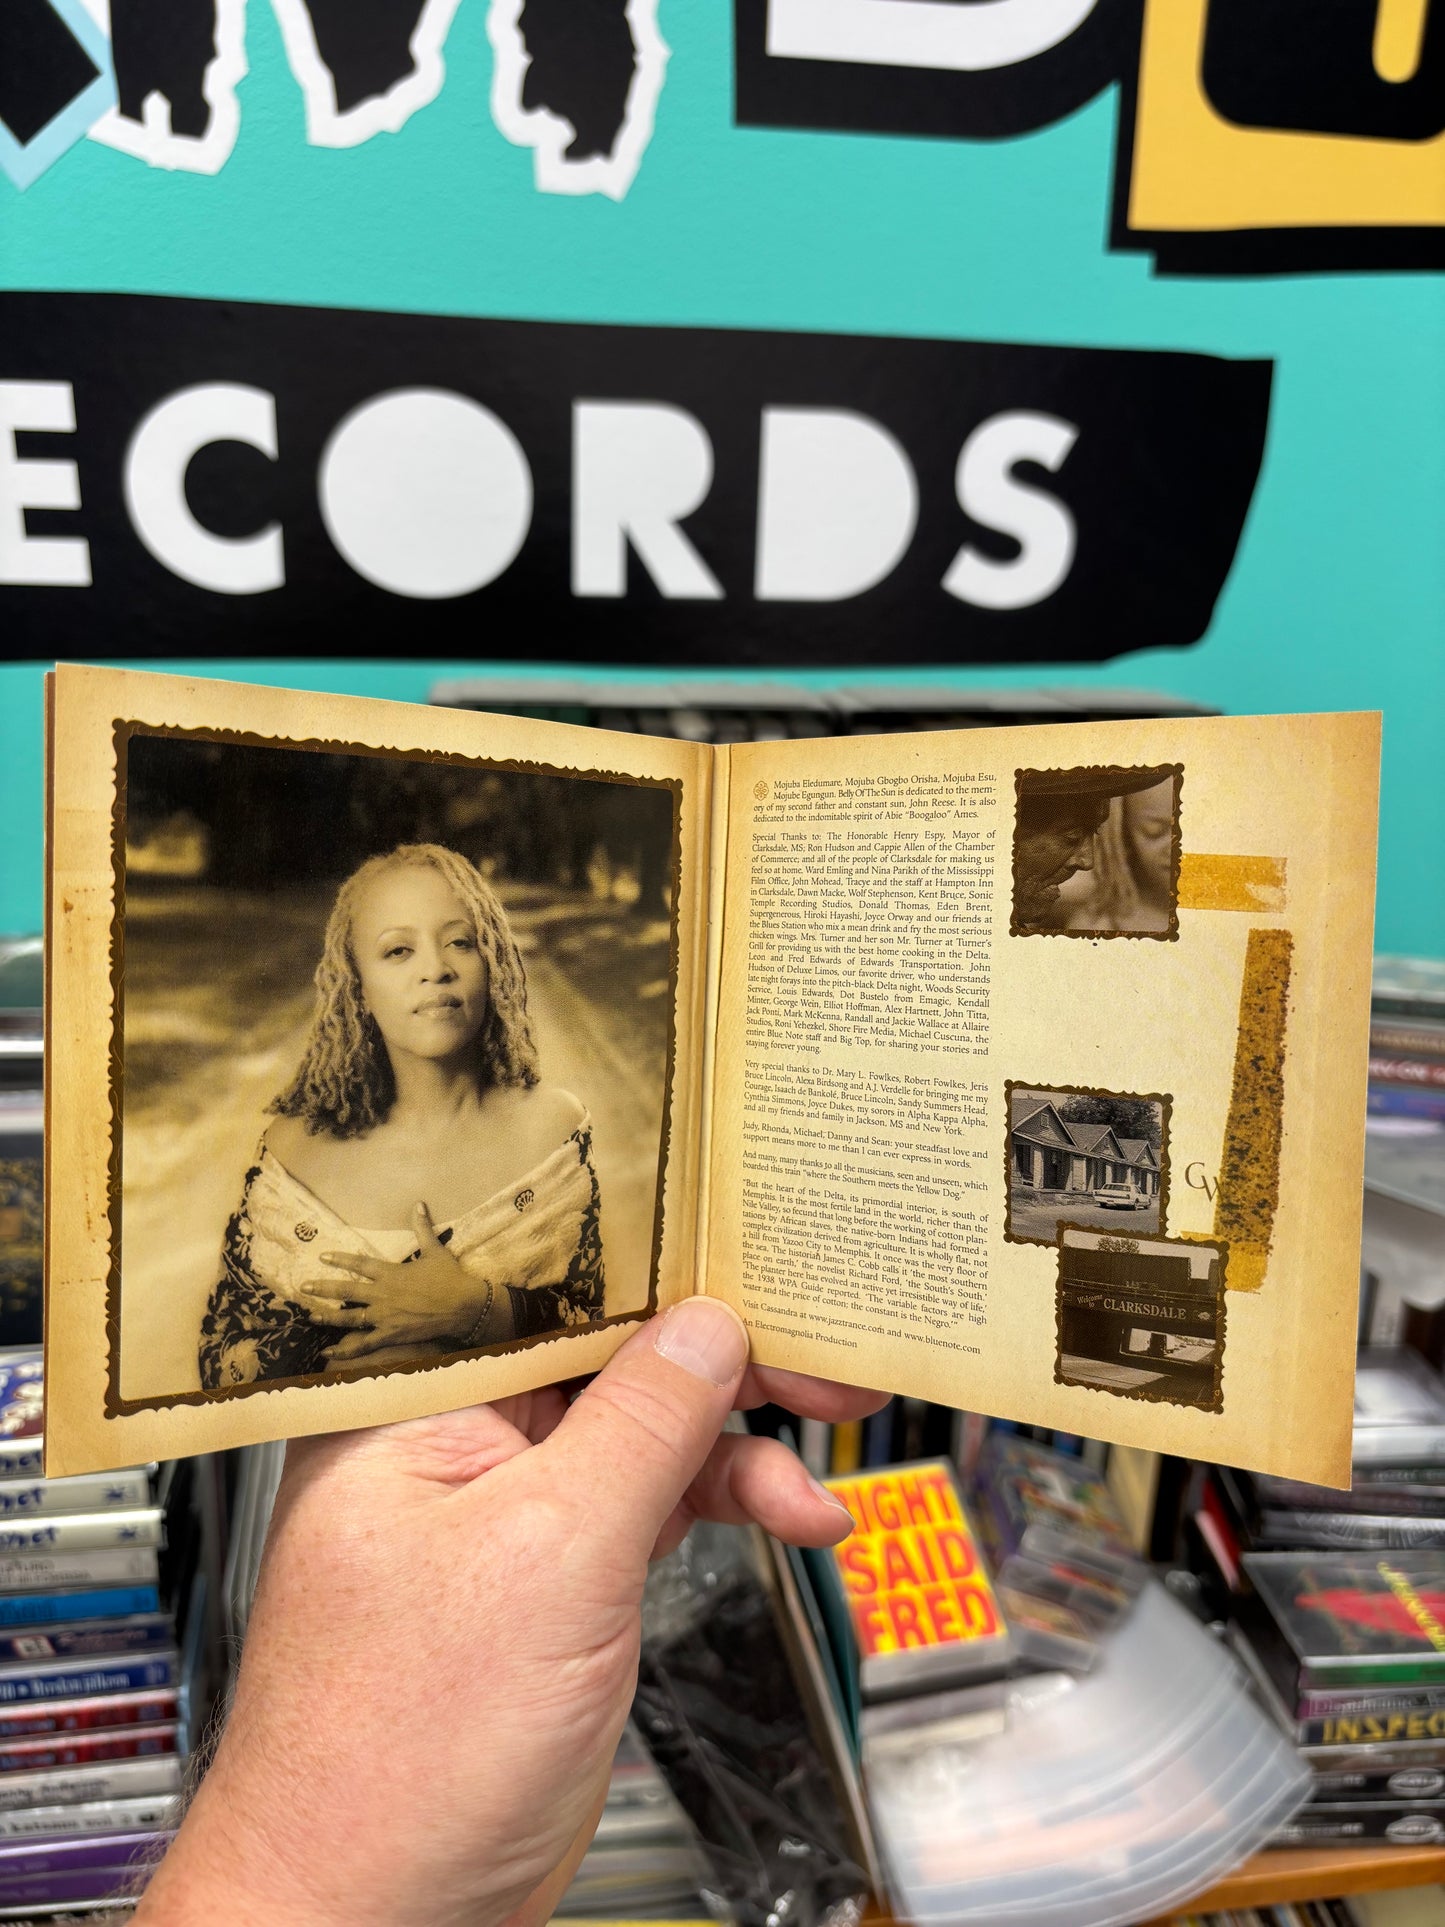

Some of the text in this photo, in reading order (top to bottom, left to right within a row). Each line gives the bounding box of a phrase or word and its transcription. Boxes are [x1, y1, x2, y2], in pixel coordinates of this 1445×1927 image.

[773, 772, 996, 791] Mojuba Eledumare, Mojuba Gbogbo Orisha, Mojuba Esu,
[751, 843, 788, 852] Clarksdale,
[807, 843, 822, 852] Ron
[824, 842, 854, 851] Hudson
[856, 842, 871, 851] and
[872, 842, 901, 854] Cappie
[903, 842, 924, 851] Allen
[927, 842, 937, 851] of
[938, 842, 952, 851] the
[954, 841, 995, 851] Chamber
[752, 832, 776, 843] Special
[780, 832, 807, 840] Thanks
[826, 831, 842, 840] The
[846, 831, 888, 840] Honorable
[893, 830, 918, 841] Henry
[924, 830, 945, 841] Espy,
[952, 829, 980, 841] Mayor
[986, 829, 996, 838] of
[750, 897, 992, 912] Temple Recording Studios, Donald Thomas, Eden Brent,
[758, 887, 795, 896] Clarksdale,
[797, 887, 818, 896] Dawn
[819, 888, 846, 897] Macke,
[847, 888, 867, 897] Wolf
[867, 888, 916, 900] Stephenson,
[918, 889, 938, 898] Kent
[940, 889, 966, 900] Bruce,
[968, 890, 993, 899] Sonic
[748, 952, 990, 972] Leon and Fred Edwards of Edwards Transportation. John
[748, 962, 774, 972] Hudson
[776, 964, 784, 973] of
[786, 964, 812, 974] Deluxe
[814, 966, 839, 976] Limos,
[858, 968, 887, 978] favorite
[889, 970, 914, 980] driver,
[917, 971, 935, 981] who
[938, 972, 990, 983] understands
[746, 994, 771, 1005] Minter,
[772, 996, 798, 1008] George
[800, 998, 821, 1009] Wein,
[845, 1001, 882, 1013] Hoffman,
[884, 1004, 902, 1014] Alex
[944, 1007, 963, 1018] John
[966, 1009, 989, 1020] Titta,
[776, 986, 797, 995] Louis
[840, 989, 854, 999] Dot
[859, 991, 889, 1001] Bustelo
[894, 993, 913, 1003] from
[957, 997, 989, 1008] Kendall
[745, 1006, 760, 1015] Jack
[761, 1007, 781, 1017] Ponti,
[783, 1008, 803, 1018] Mark
[804, 1010, 842, 1022] McKenna,
[844, 1012, 873, 1023] Randall
[875, 1015, 890, 1024] and
[891, 1016, 915, 1026] Jackie
[917, 1017, 949, 1028] Wallace
[961, 1021, 989, 1031] Allaire
[771, 1094, 806, 1107] Simmons,
[807, 1098, 827, 1110] Joyce
[829, 1100, 855, 1112] Dukes,
[857, 1106, 869, 1115] my
[870, 1107, 894, 1116] sorors
[897, 1108, 905, 1117] in
[907, 1109, 930, 1121] Alpha
[933, 1112, 958, 1125] Kappa
[960, 1115, 988, 1128] Alpha,
[774, 1084, 796, 1094] Isaach
[797, 1086, 806, 1095] de
[840, 1090, 862, 1101] Bruce
[864, 1093, 896, 1105] Lincoln,
[897, 1096, 922, 1110] Sandy
[923, 1099, 961, 1112] Summers
[963, 1104, 988, 1116] Head,
[742, 1210, 766, 1220] tations
[768, 1212, 777, 1224] by
[779, 1215, 806, 1226] African
[809, 1219, 832, 1231] slaves,
[835, 1223, 848, 1233] the
[850, 1227, 895, 1241] native-born
[898, 1233, 928, 1246] Indians
[931, 1238, 946, 1249] had
[949, 1241, 979, 1255] formed
[742, 1270, 753, 1280] the
[758, 1273, 774, 1284] 1938
[778, 1276, 797, 1288] WPA
[800, 1281, 823, 1292] Guide
[827, 1288, 861, 1299] reported.
[887, 1298, 917, 1310] variable
[920, 1303, 947, 1316] factors
[951, 1311, 964, 1320] are
[968, 1312, 986, 1325] high
[1076, 1293, 1103, 1305] Welcome
[1103, 1298, 1187, 1320] CLARKSDALE
[742, 1298, 758, 1309] Visit
[760, 1302, 797, 1317] Cassandra
[808, 1313, 884, 1334] www.jazztrance.com
[886, 1328, 901, 1337] and
[904, 1332, 980, 1354] www.bluenote.com
[742, 1317, 857, 1348] An Electromagnolia Production
[842, 1531, 976, 1595] SAID
[851, 1583, 998, 1655] FRED
